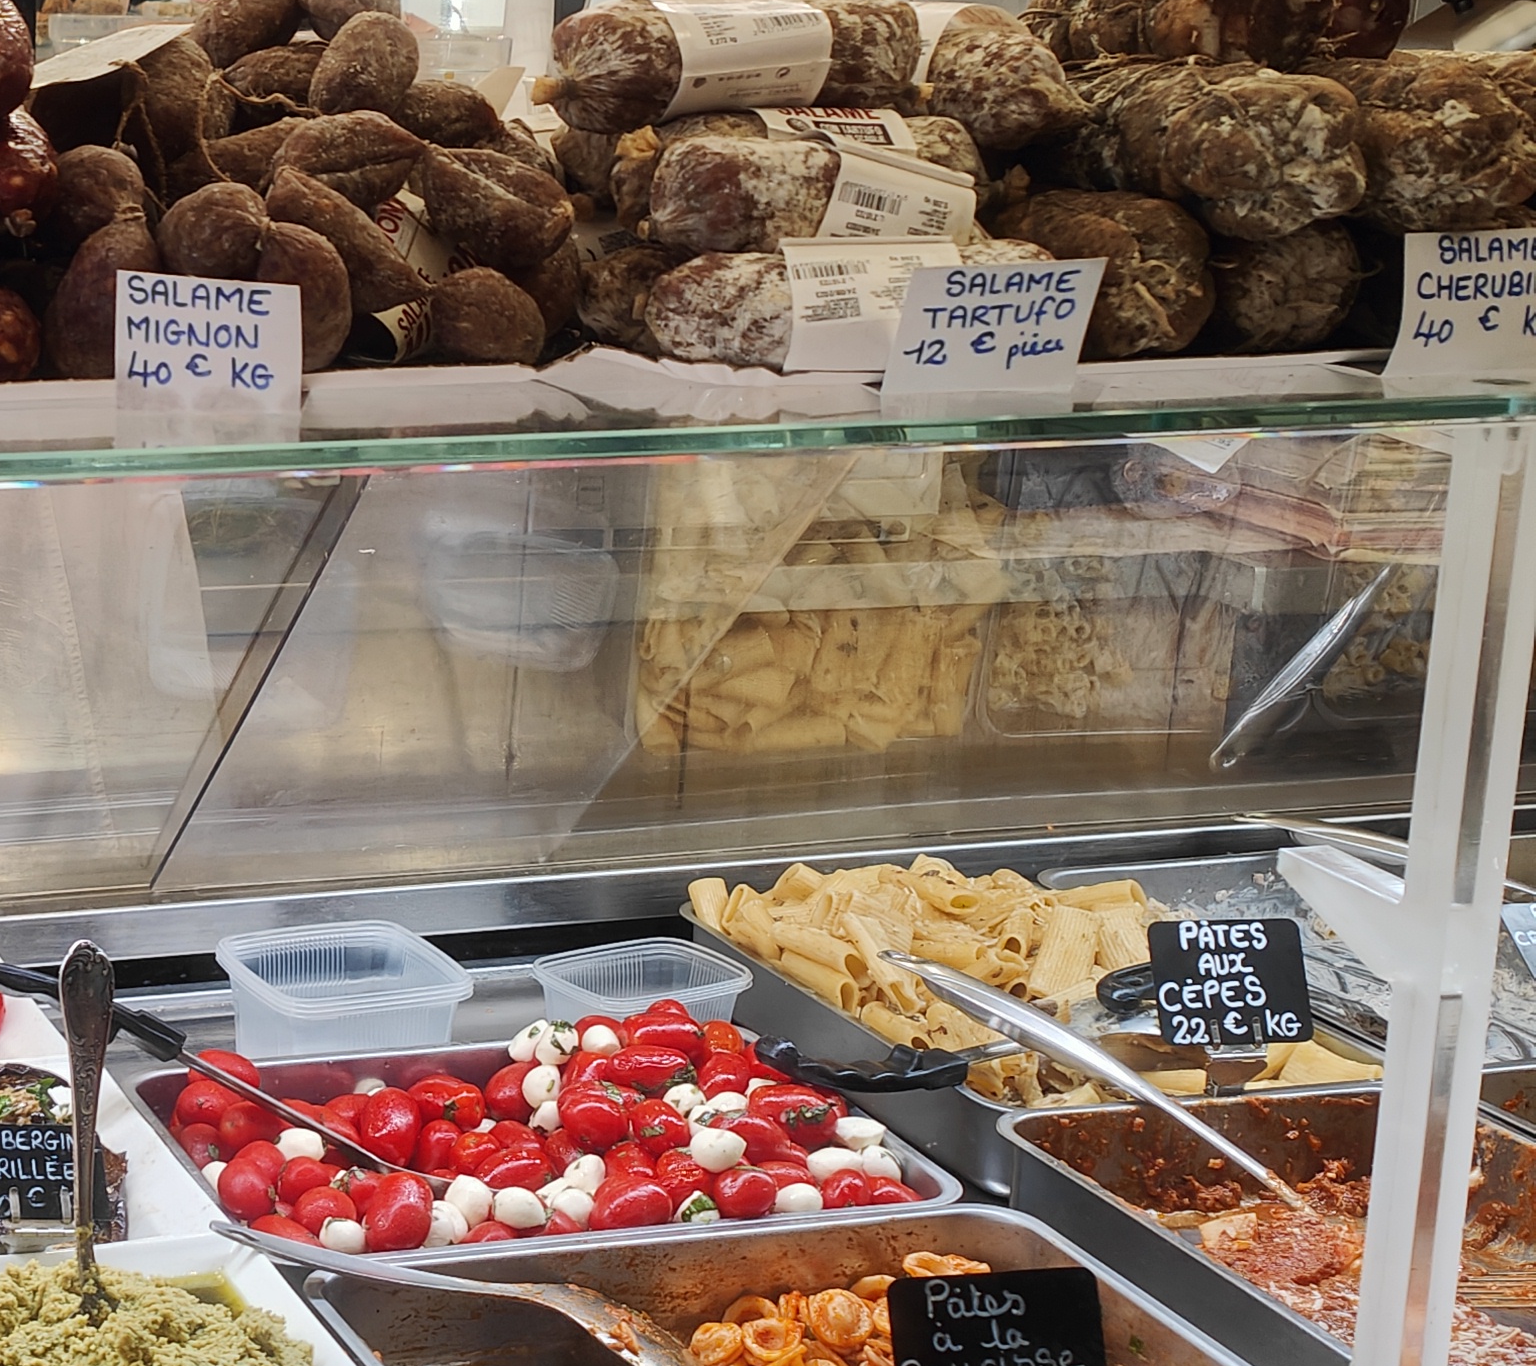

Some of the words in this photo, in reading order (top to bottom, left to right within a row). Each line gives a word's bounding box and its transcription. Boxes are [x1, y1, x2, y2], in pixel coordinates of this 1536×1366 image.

[128, 275, 272, 316] SALAME
[946, 269, 1081, 297] SALAME
[1417, 270, 1536, 301] CHERUBI
[127, 316, 259, 349] MIGNON
[1412, 310, 1454, 348] 40
[1478, 305, 1500, 331] €
[903, 339, 947, 365] 12
[971, 331, 996, 354] €
[127, 351, 172, 388] 40
[185, 353, 212, 377] €
[232, 357, 274, 390] KG
[1172, 1015, 1211, 1044] 22
[1223, 1010, 1248, 1035] €
[1265, 1008, 1302, 1038] KG
[26, 1187, 46, 1207] €
[980, 1319, 1029, 1350] la
